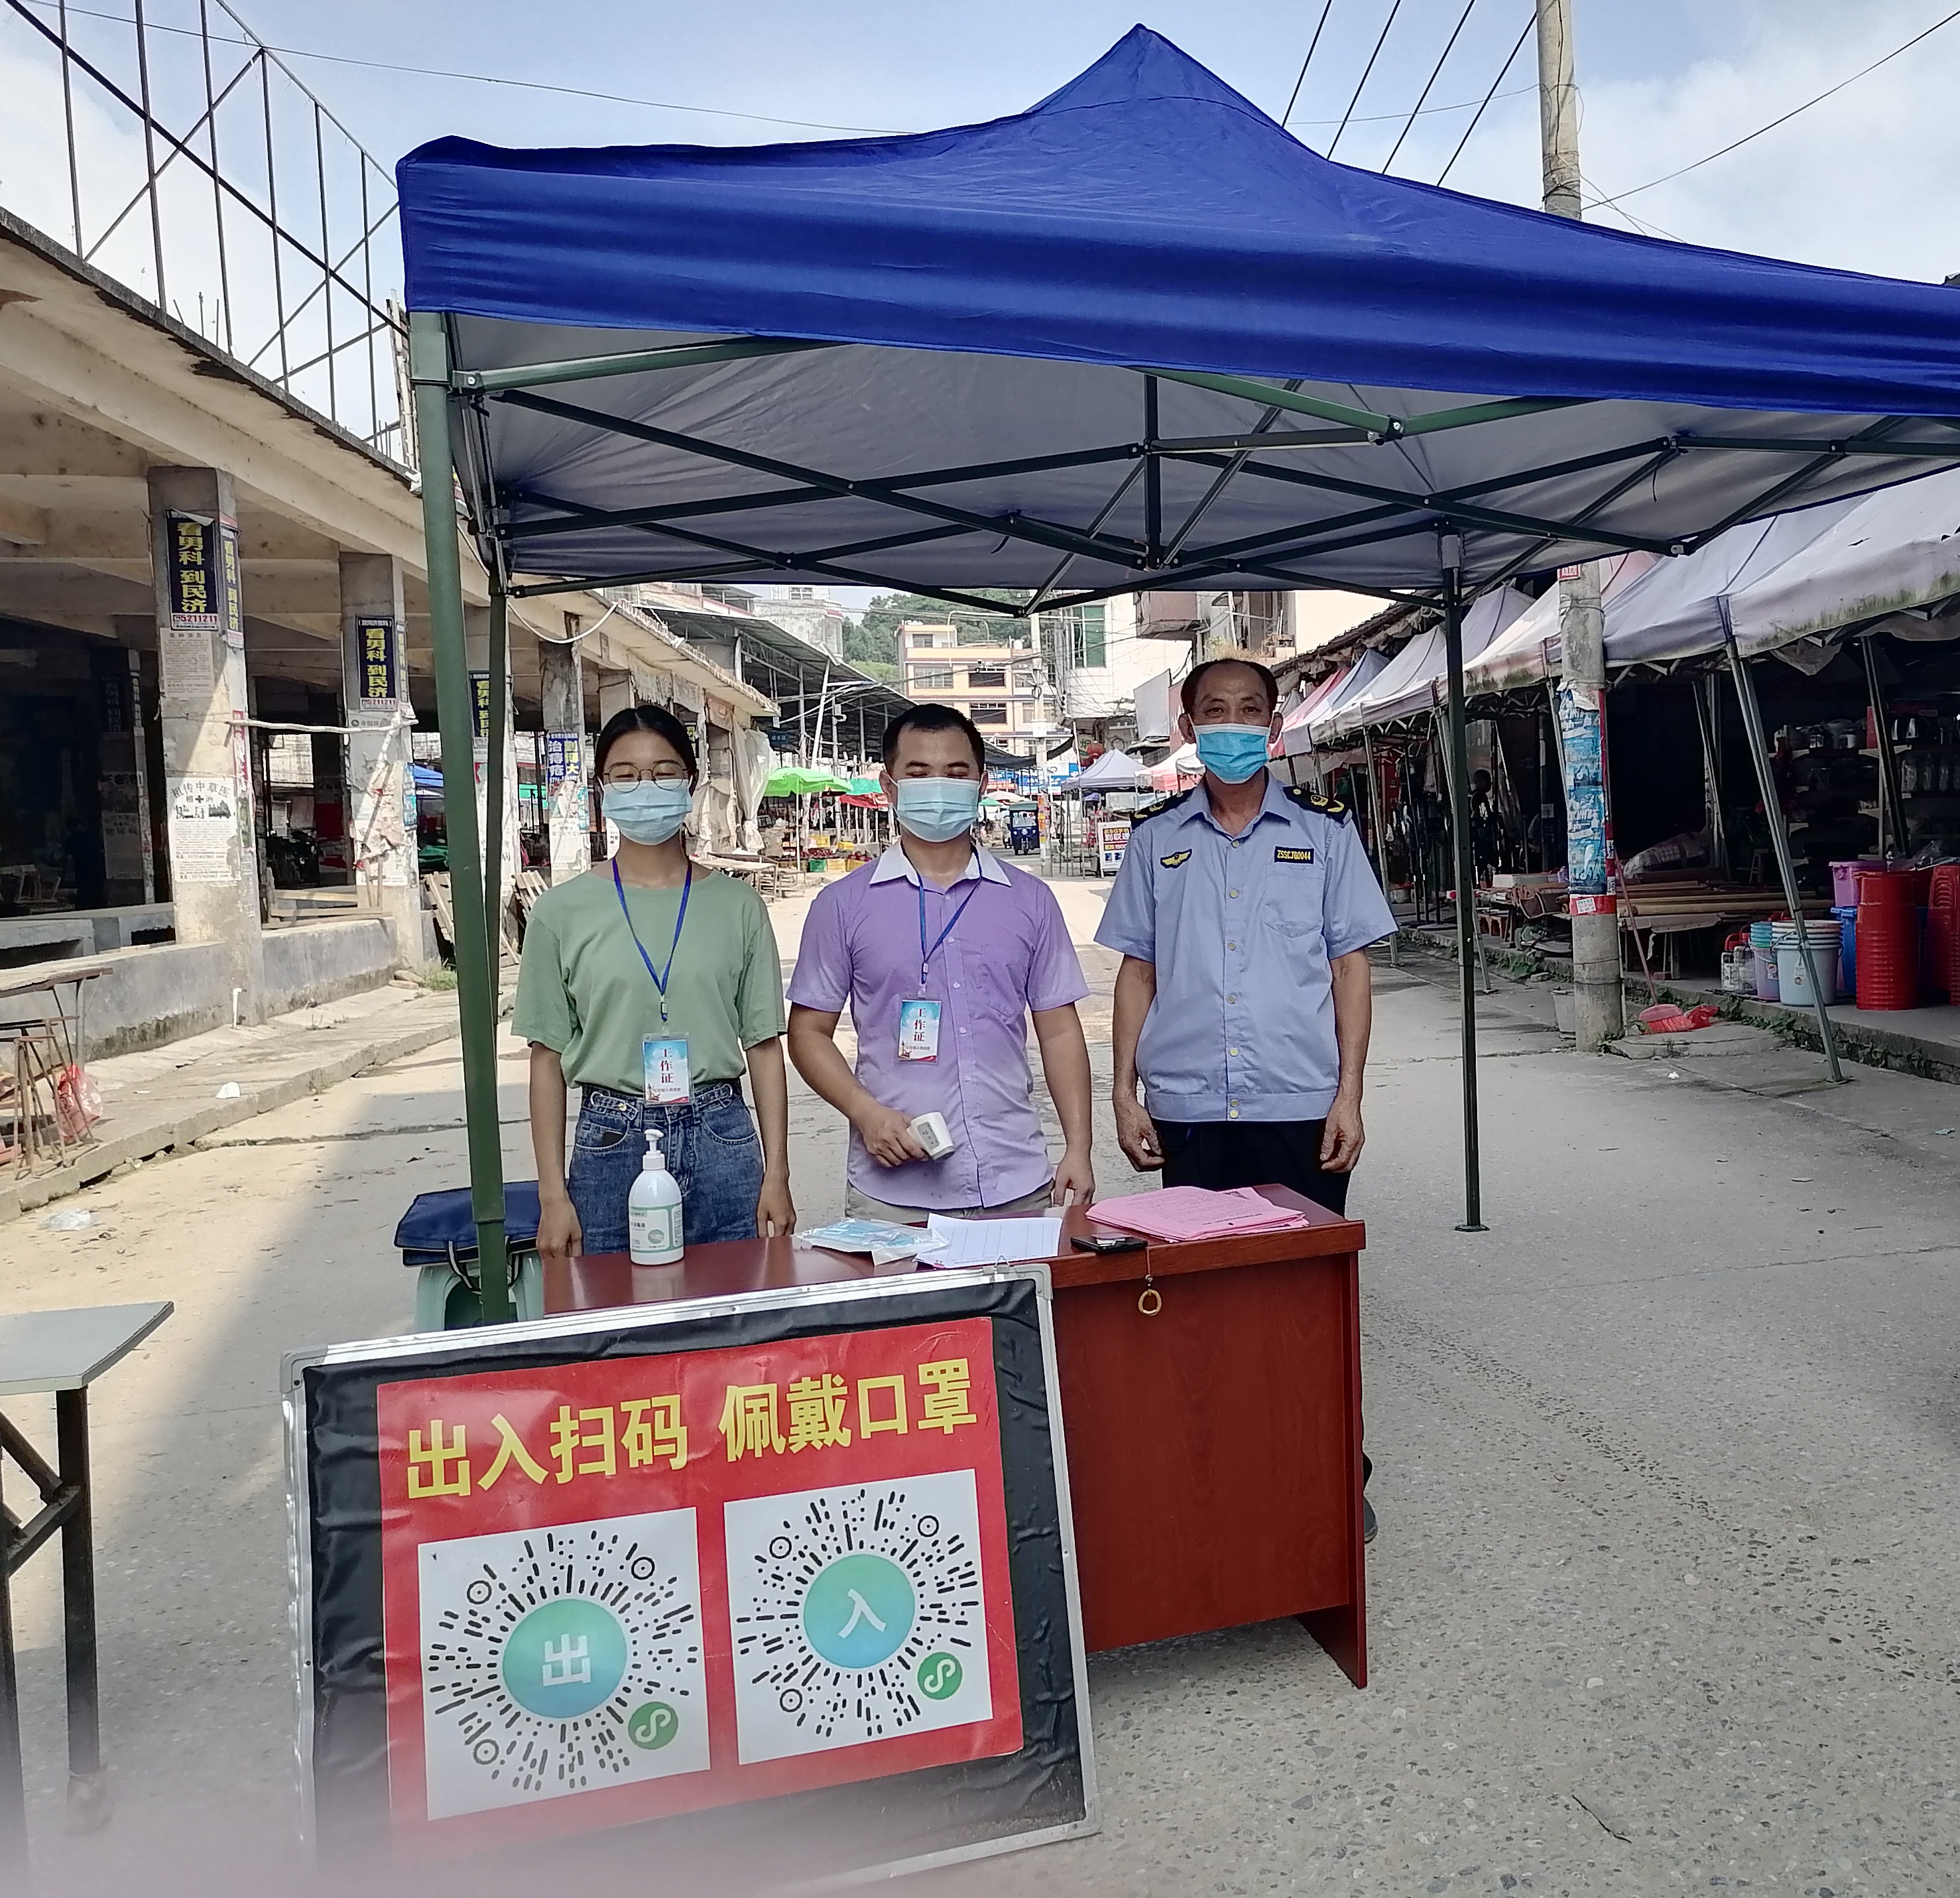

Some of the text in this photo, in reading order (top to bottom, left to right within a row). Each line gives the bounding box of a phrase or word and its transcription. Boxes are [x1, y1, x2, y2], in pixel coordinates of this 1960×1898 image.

[177, 522, 205, 565] 看男科
[180, 570, 207, 613] 到民济
[913, 1007, 927, 1042] 工作证
[658, 1047, 674, 1084] 工作证
[406, 1358, 978, 1499] 出入扫码 佩戴口罩
[838, 1588, 887, 1639] 入
[542, 1632, 593, 1688] 出
